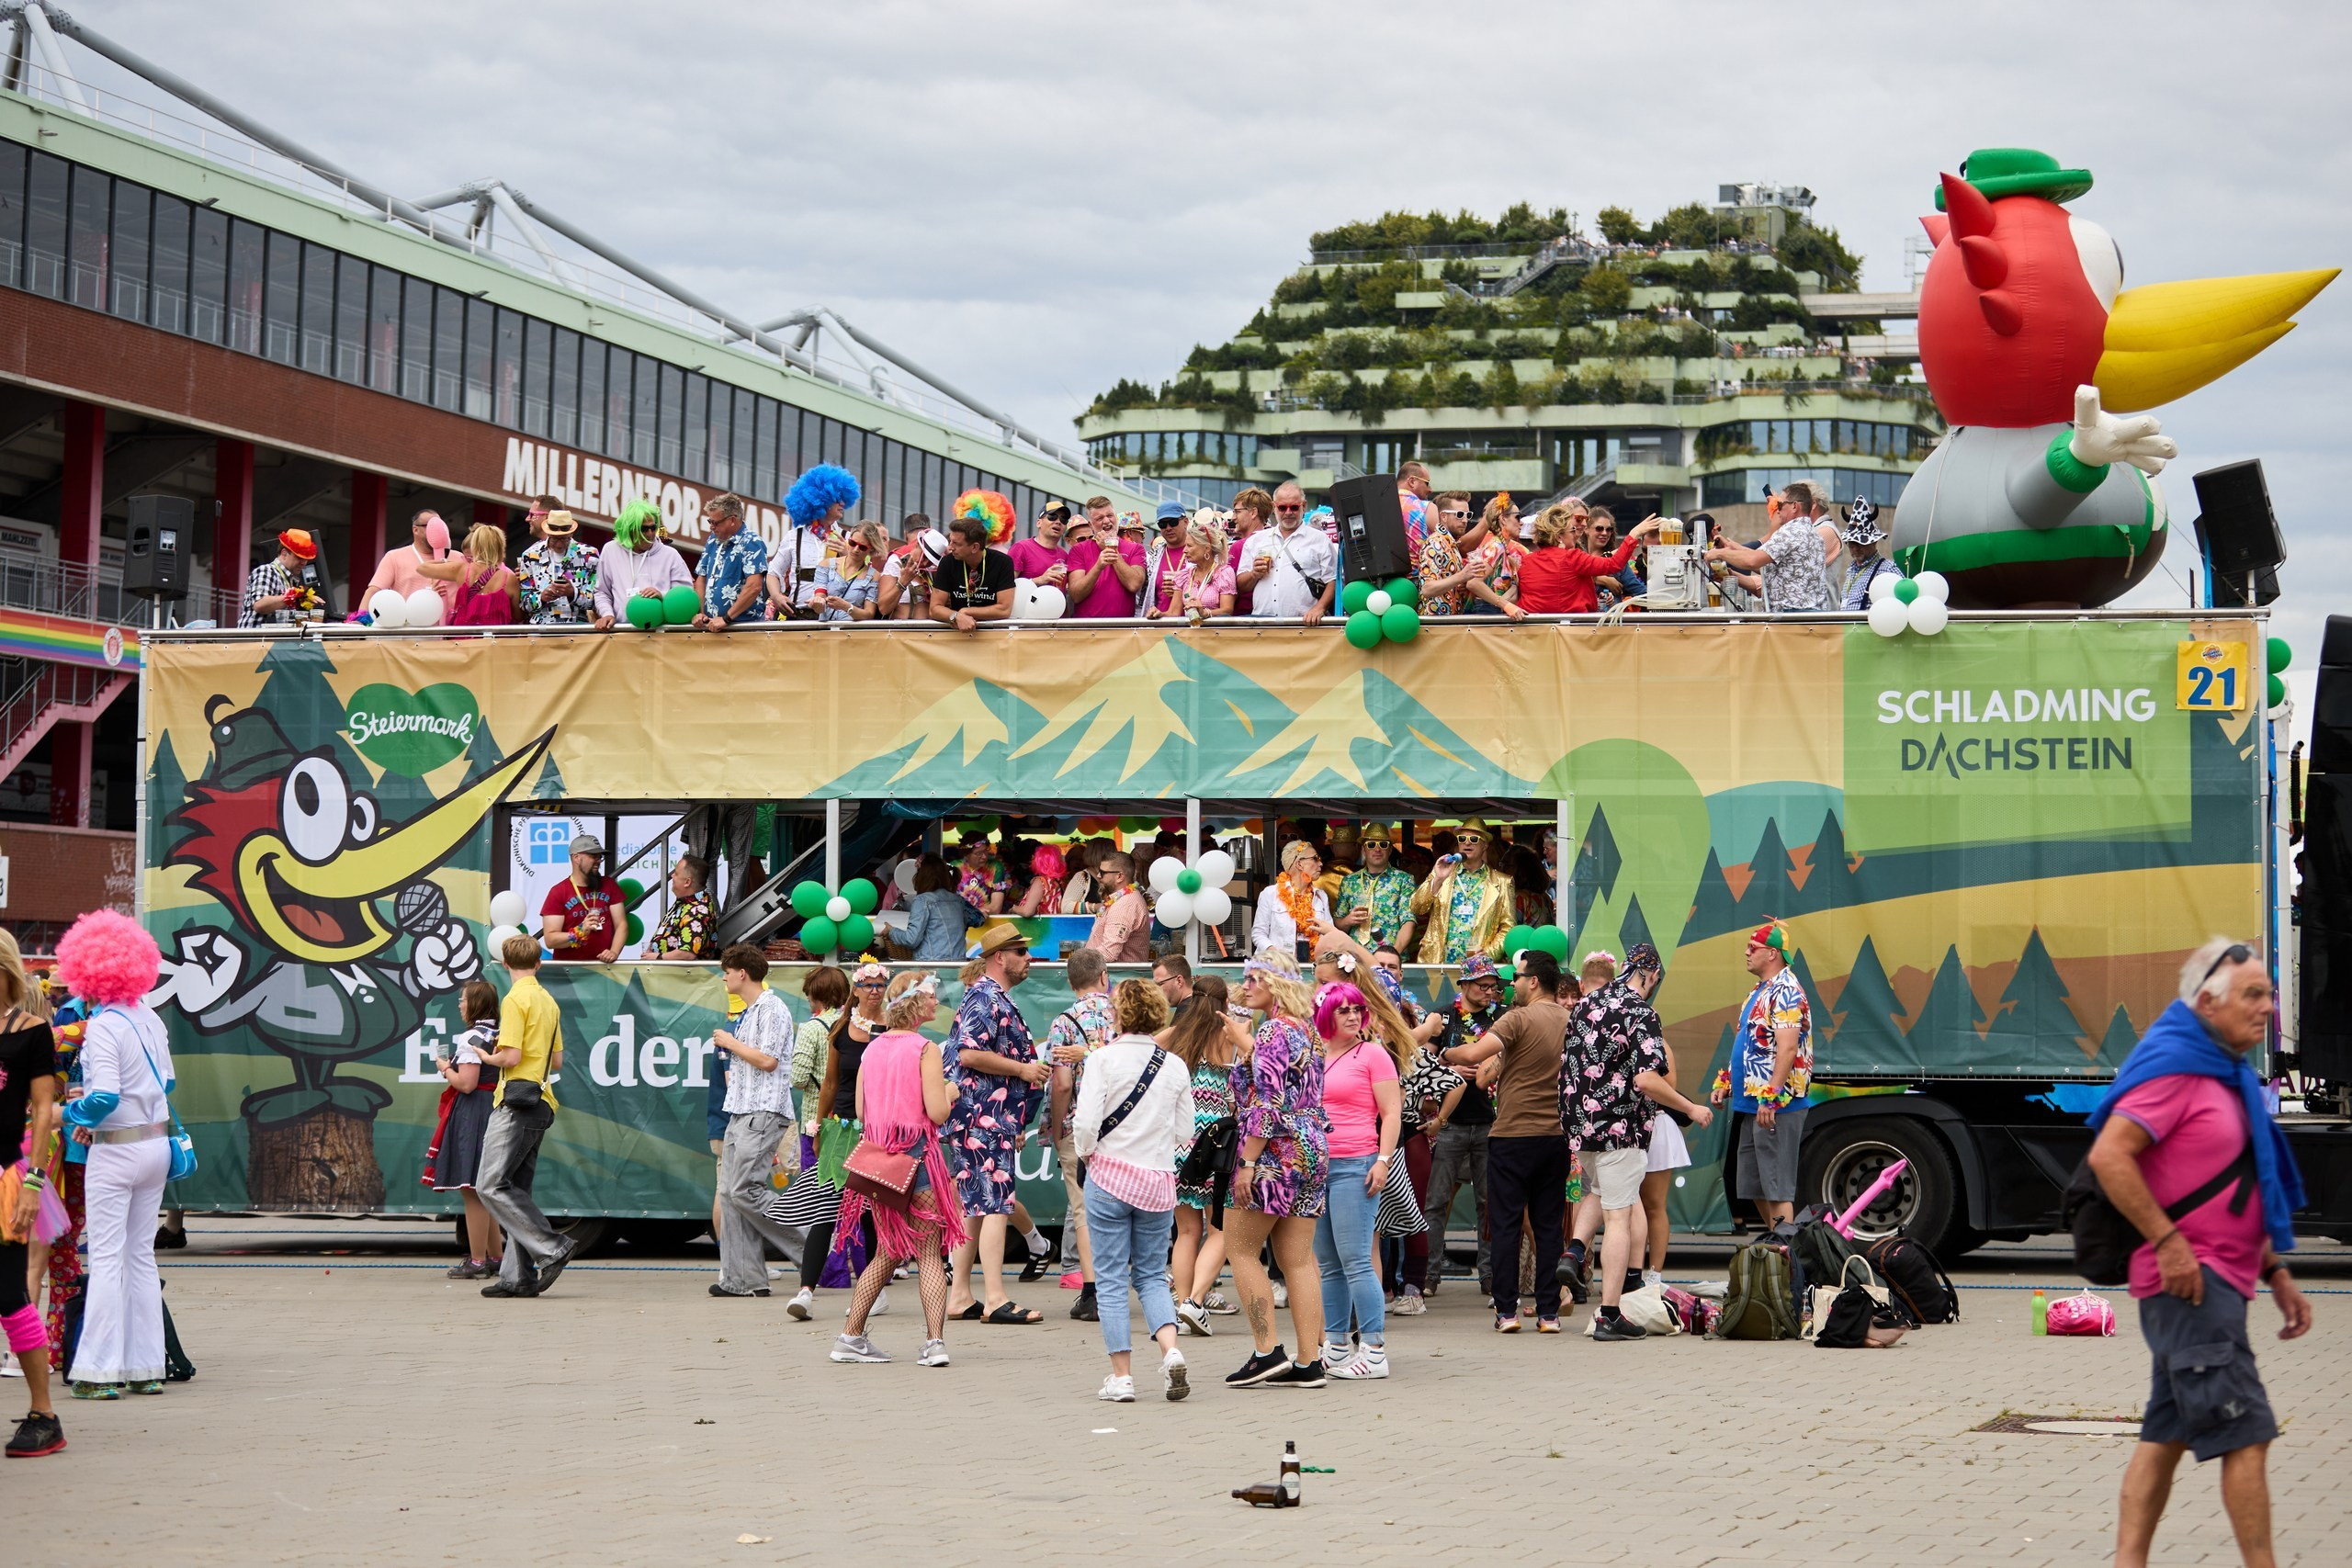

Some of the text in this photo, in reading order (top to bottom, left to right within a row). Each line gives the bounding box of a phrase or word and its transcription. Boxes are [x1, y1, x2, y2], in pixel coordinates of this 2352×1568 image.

[503, 437, 792, 559] MILLERNTOR-ADI
[1877, 688, 2156, 724] SCHLADMING
[2188, 666, 2235, 706] 21
[349, 711, 474, 745] Steiermark
[1901, 731, 2132, 781] DACHSTEIN
[513, 827, 536, 877] DIAKONISCHE
[589, 1014, 715, 1088] der
